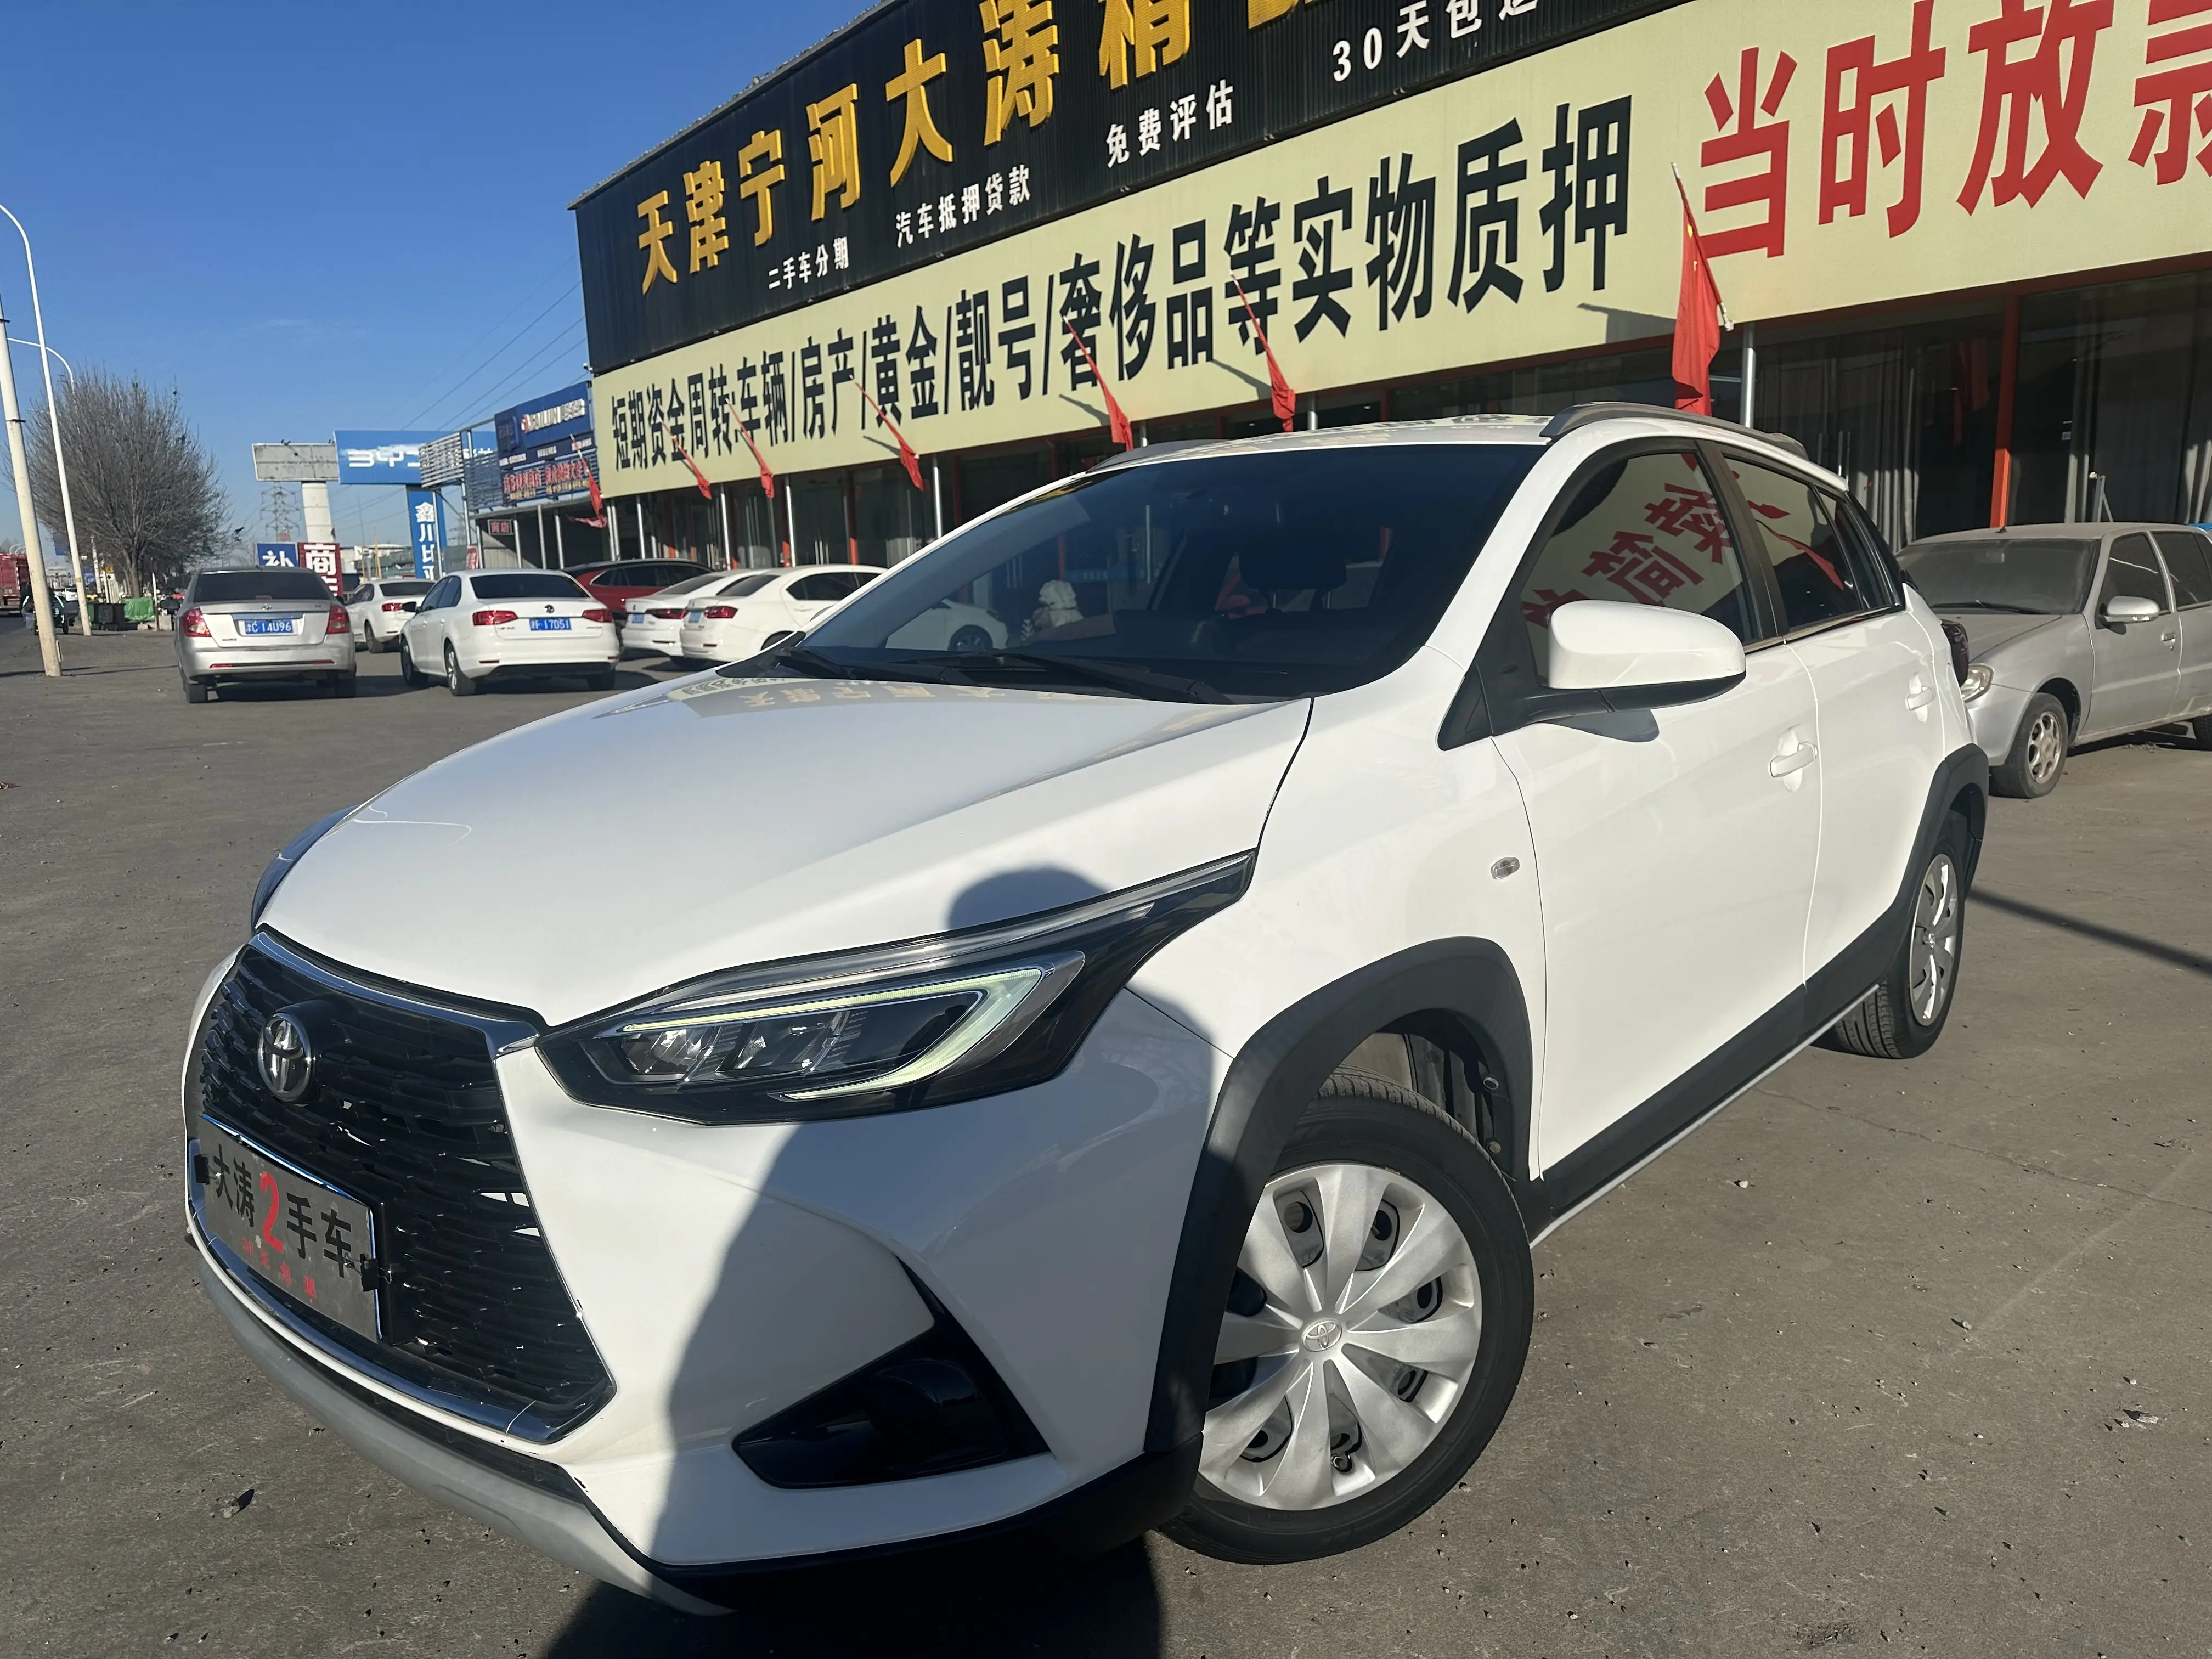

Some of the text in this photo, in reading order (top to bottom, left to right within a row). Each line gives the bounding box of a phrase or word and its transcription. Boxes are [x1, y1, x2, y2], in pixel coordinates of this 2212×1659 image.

[1106, 79, 1234, 168] 免费评估
[896, 165, 1031, 249] 汽车抵押贷款
[768, 236, 849, 290] 二手车分期
[213, 1143, 355, 1278] 大涛2手车
